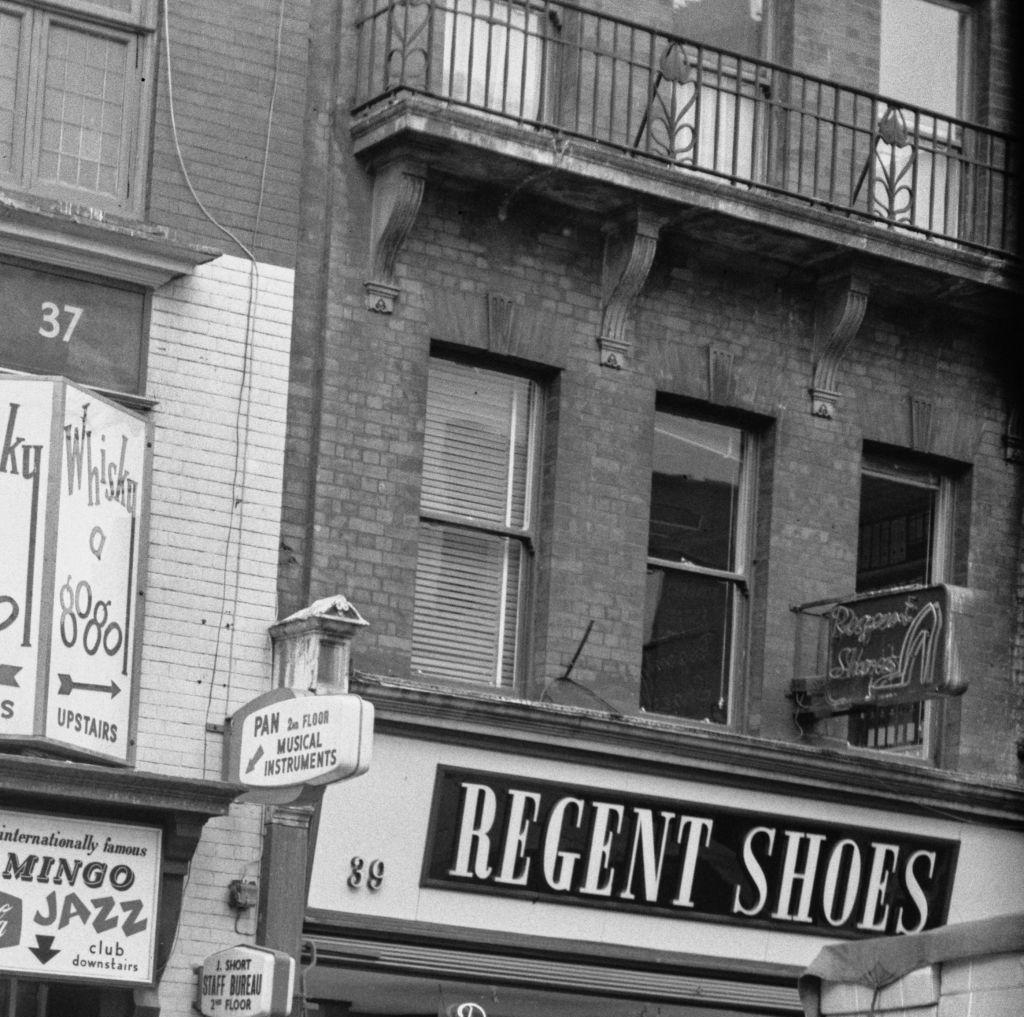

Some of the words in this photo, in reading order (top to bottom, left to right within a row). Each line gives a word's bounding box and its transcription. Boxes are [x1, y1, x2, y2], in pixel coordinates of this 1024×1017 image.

[38, 301, 84, 343] 37
[88, 526, 107, 560] a
[59, 574, 123, 656] gogo
[57, 707, 118, 743] UPSTAIRS
[254, 712, 280, 738] PAN
[302, 710, 330, 729] FLOOR
[277, 731, 323, 755] MUSICAL
[264, 748, 337, 777] INSTRUMENTS
[103, 836, 148, 858] famous
[449, 781, 714, 909] REGENT
[732, 825, 937, 935] SHOES
[346, 855, 386, 891] 39
[33, 890, 148, 938] JAZZ
[89, 940, 125, 957] club
[72, 955, 139, 973] downstairs
[225, 958, 252, 971] SHORT
[203, 974, 226, 996] STAFF
[230, 973, 263, 996] BUREAU
[225, 998, 251, 1011] FLOOR
